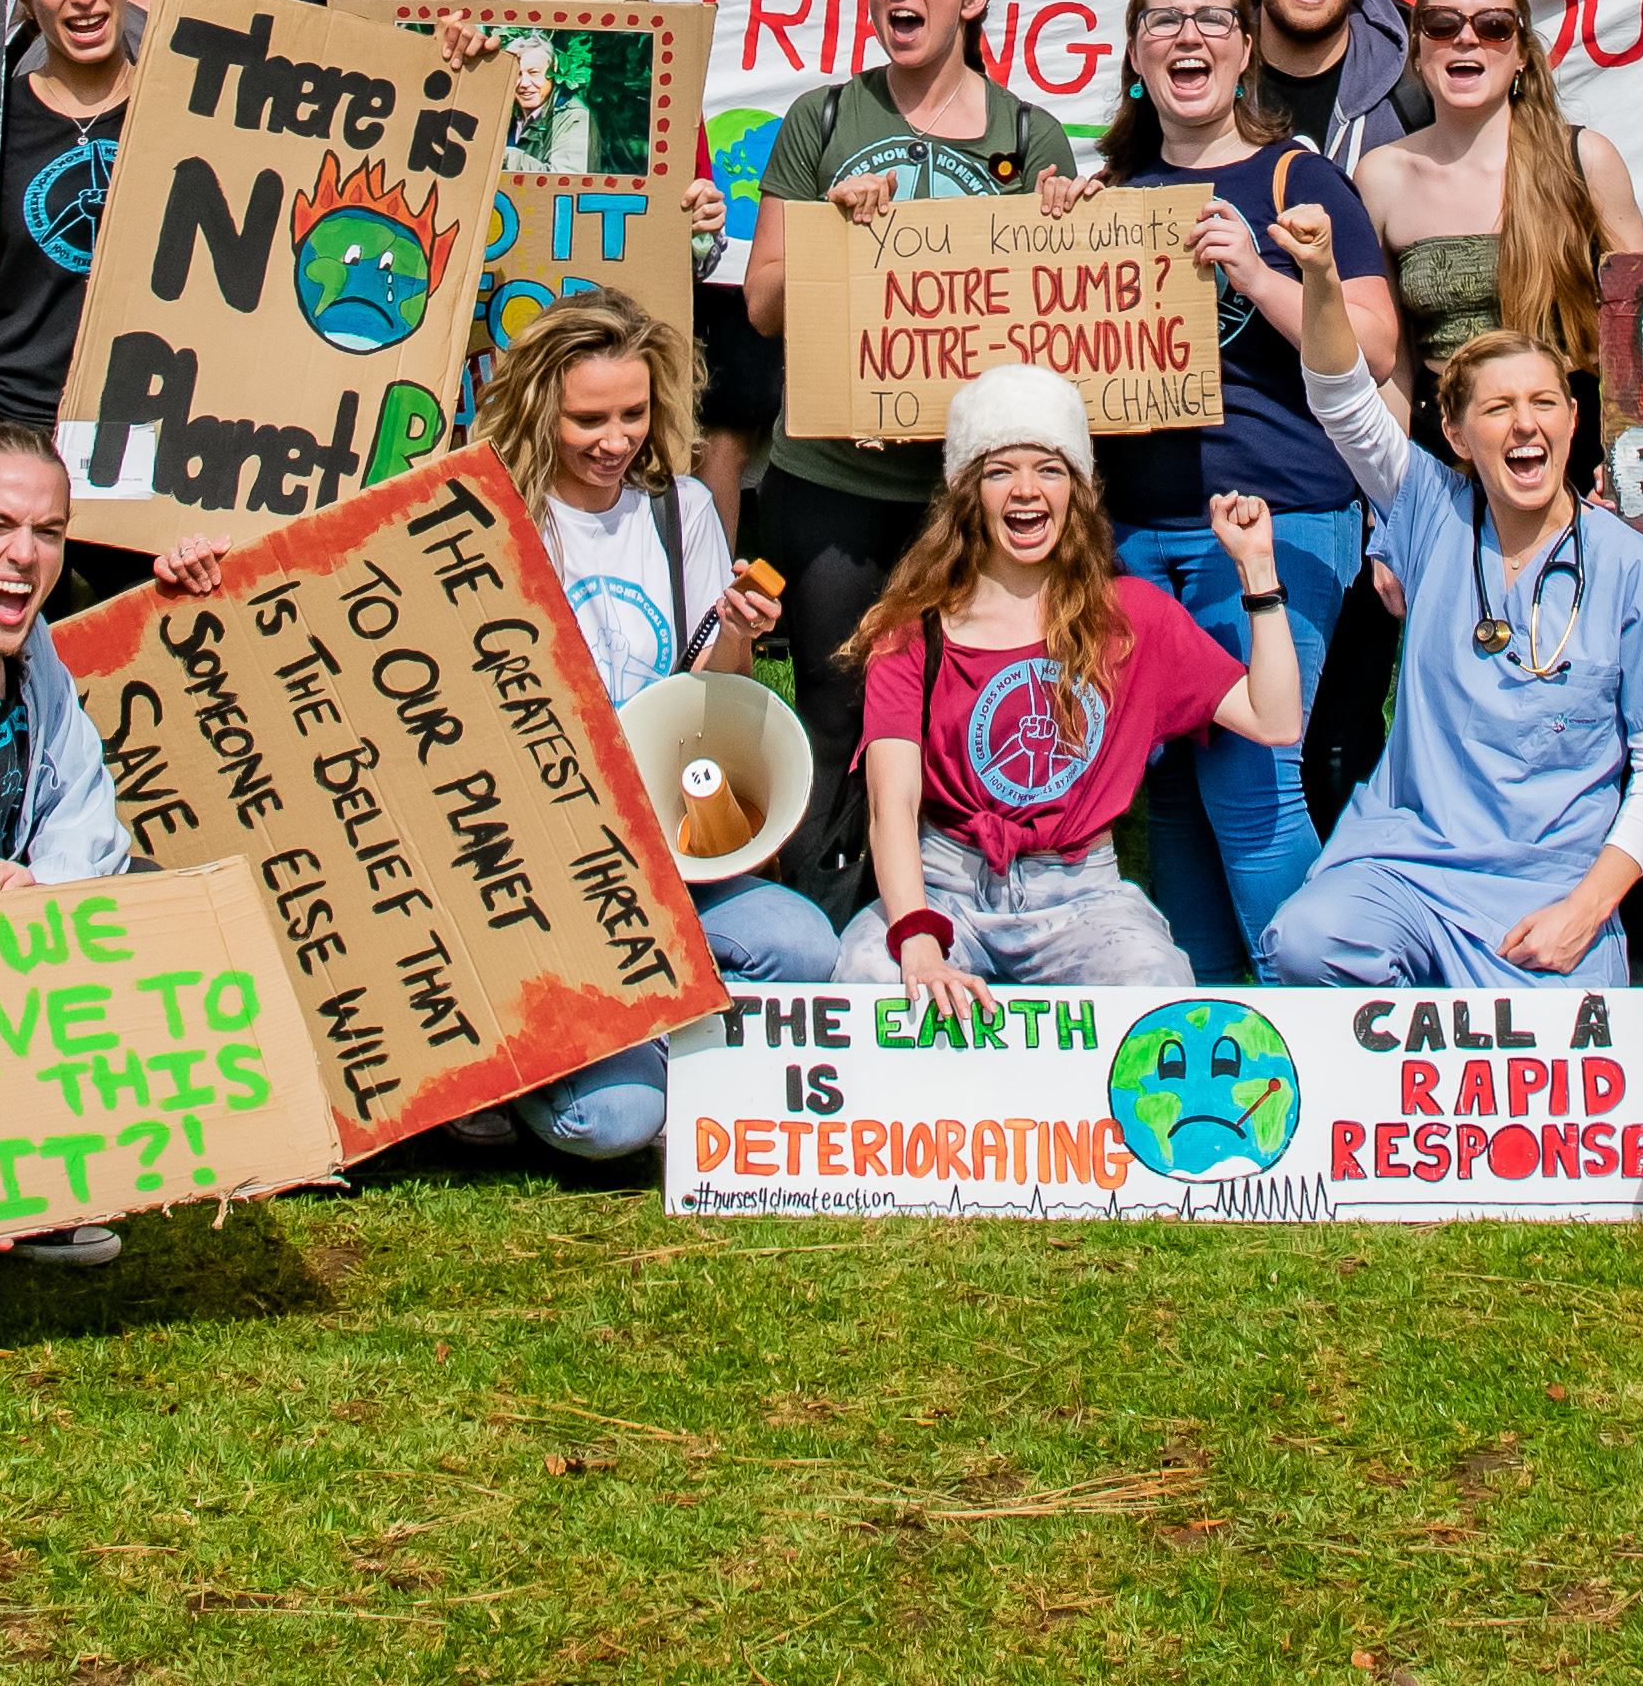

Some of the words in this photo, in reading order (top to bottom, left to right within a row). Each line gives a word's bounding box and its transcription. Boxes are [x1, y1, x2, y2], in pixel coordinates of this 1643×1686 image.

[169, 13, 396, 150] There
[406, 70, 479, 178] is
[59, 150, 85, 167] NOW
[936, 153, 953, 171] NO
[953, 166, 984, 192] NEW
[551, 192, 649, 262] IT
[869, 208, 952, 269] You
[991, 213, 1074, 254] know
[1089, 208, 1180, 253] what's
[884, 266, 1010, 320] NOTRE
[87, 331, 361, 515] Planet
[871, 390, 919, 430] TO
[1102, 370, 1223, 424] CHANGE
[609, 582, 623, 593] NO
[643, 603, 663, 627] COAL
[659, 629, 669, 644] OR
[340, 560, 403, 639] TO
[372, 649, 464, 766] OUR
[432, 769, 551, 932] PLANET
[408, 477, 503, 606] THE
[471, 619, 600, 807] GREATEST
[570, 824, 678, 989] THREAT
[976, 723, 985, 760] GREEN
[982, 691, 998, 720] JOBS
[997, 670, 1022, 692] NOW
[104, 680, 199, 855] SAVE
[247, 579, 301, 636] IS
[275, 633, 341, 736] THE
[314, 736, 434, 915] BELIEF
[395, 930, 480, 1048] THAT
[160, 610, 284, 830] SOMEONE
[260, 847, 347, 976] ELSE
[317, 986, 402, 1121] WILL
[136, 970, 261, 1039] TO
[722, 997, 851, 1049] THE
[875, 996, 1097, 1052] EARTH
[1355, 997, 1537, 1054] CALL
[1569, 991, 1613, 1051] A
[37, 1043, 270, 1115] THIS
[786, 1063, 845, 1115] IS
[1401, 1055, 1626, 1118] RAPID
[696, 1116, 1137, 1188] DETERIORATING
